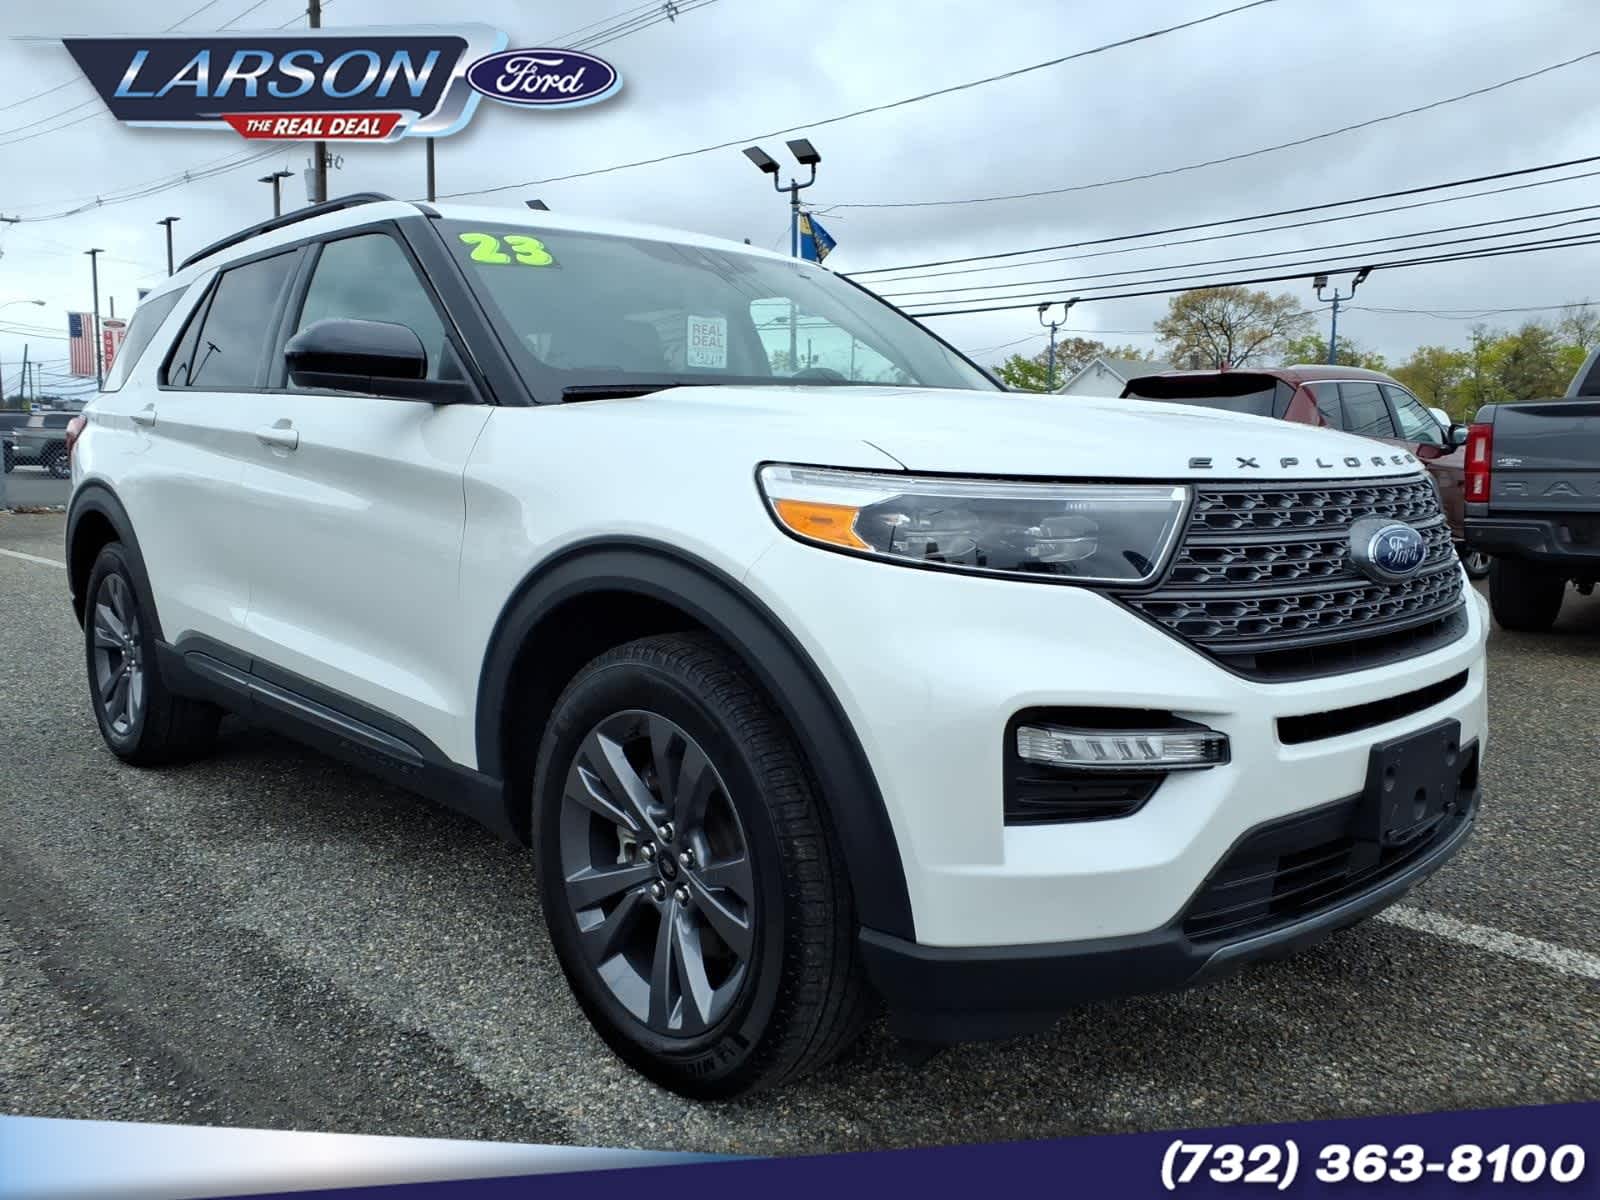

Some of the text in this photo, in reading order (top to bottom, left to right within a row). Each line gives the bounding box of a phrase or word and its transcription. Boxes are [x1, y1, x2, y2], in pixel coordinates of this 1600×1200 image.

[459, 232, 553, 266] 23
[692, 322, 722, 337] REAL
[692, 335, 723, 348] DEAL
[1387, 535, 1419, 565] Ford
